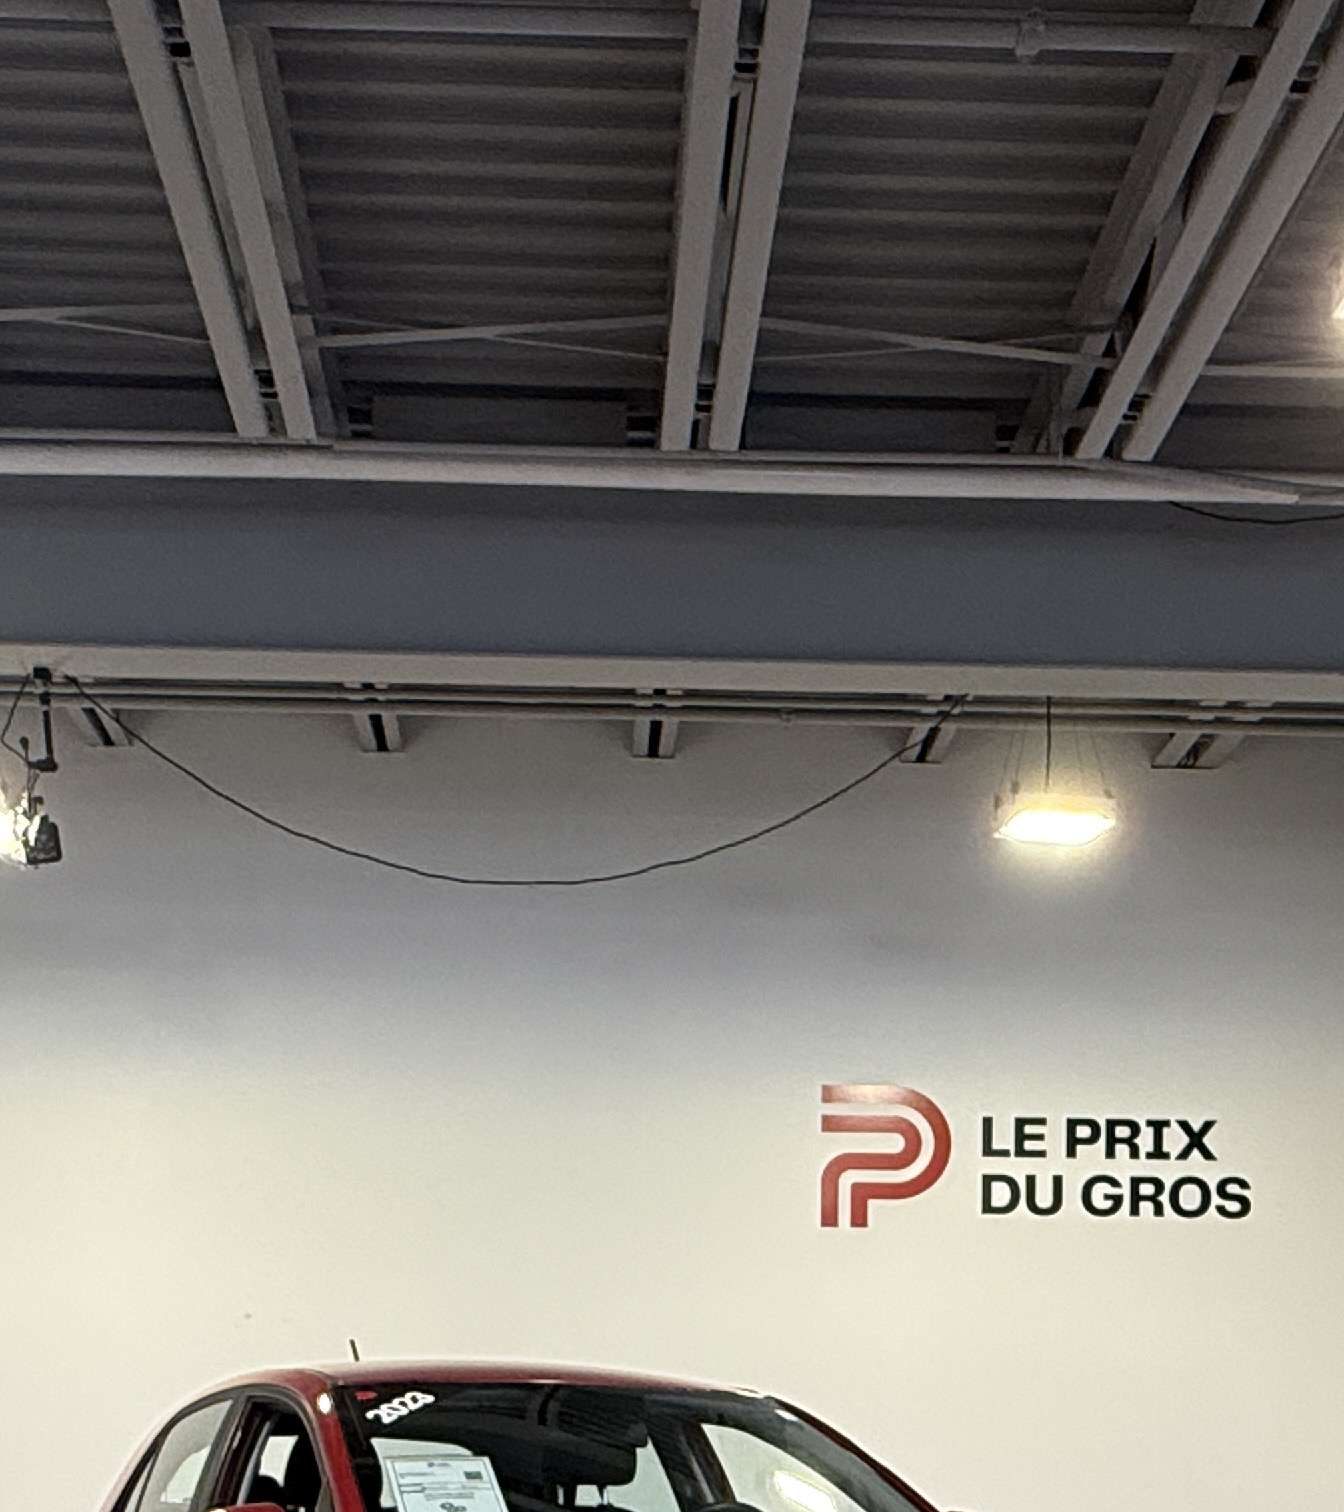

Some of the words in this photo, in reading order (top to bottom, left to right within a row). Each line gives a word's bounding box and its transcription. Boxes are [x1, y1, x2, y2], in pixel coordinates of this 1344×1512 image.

[981, 1116, 1048, 1158] LE
[1065, 1118, 1218, 1161] PRIX
[981, 1174, 1064, 1216] DU
[1081, 1175, 1252, 1220] GROS
